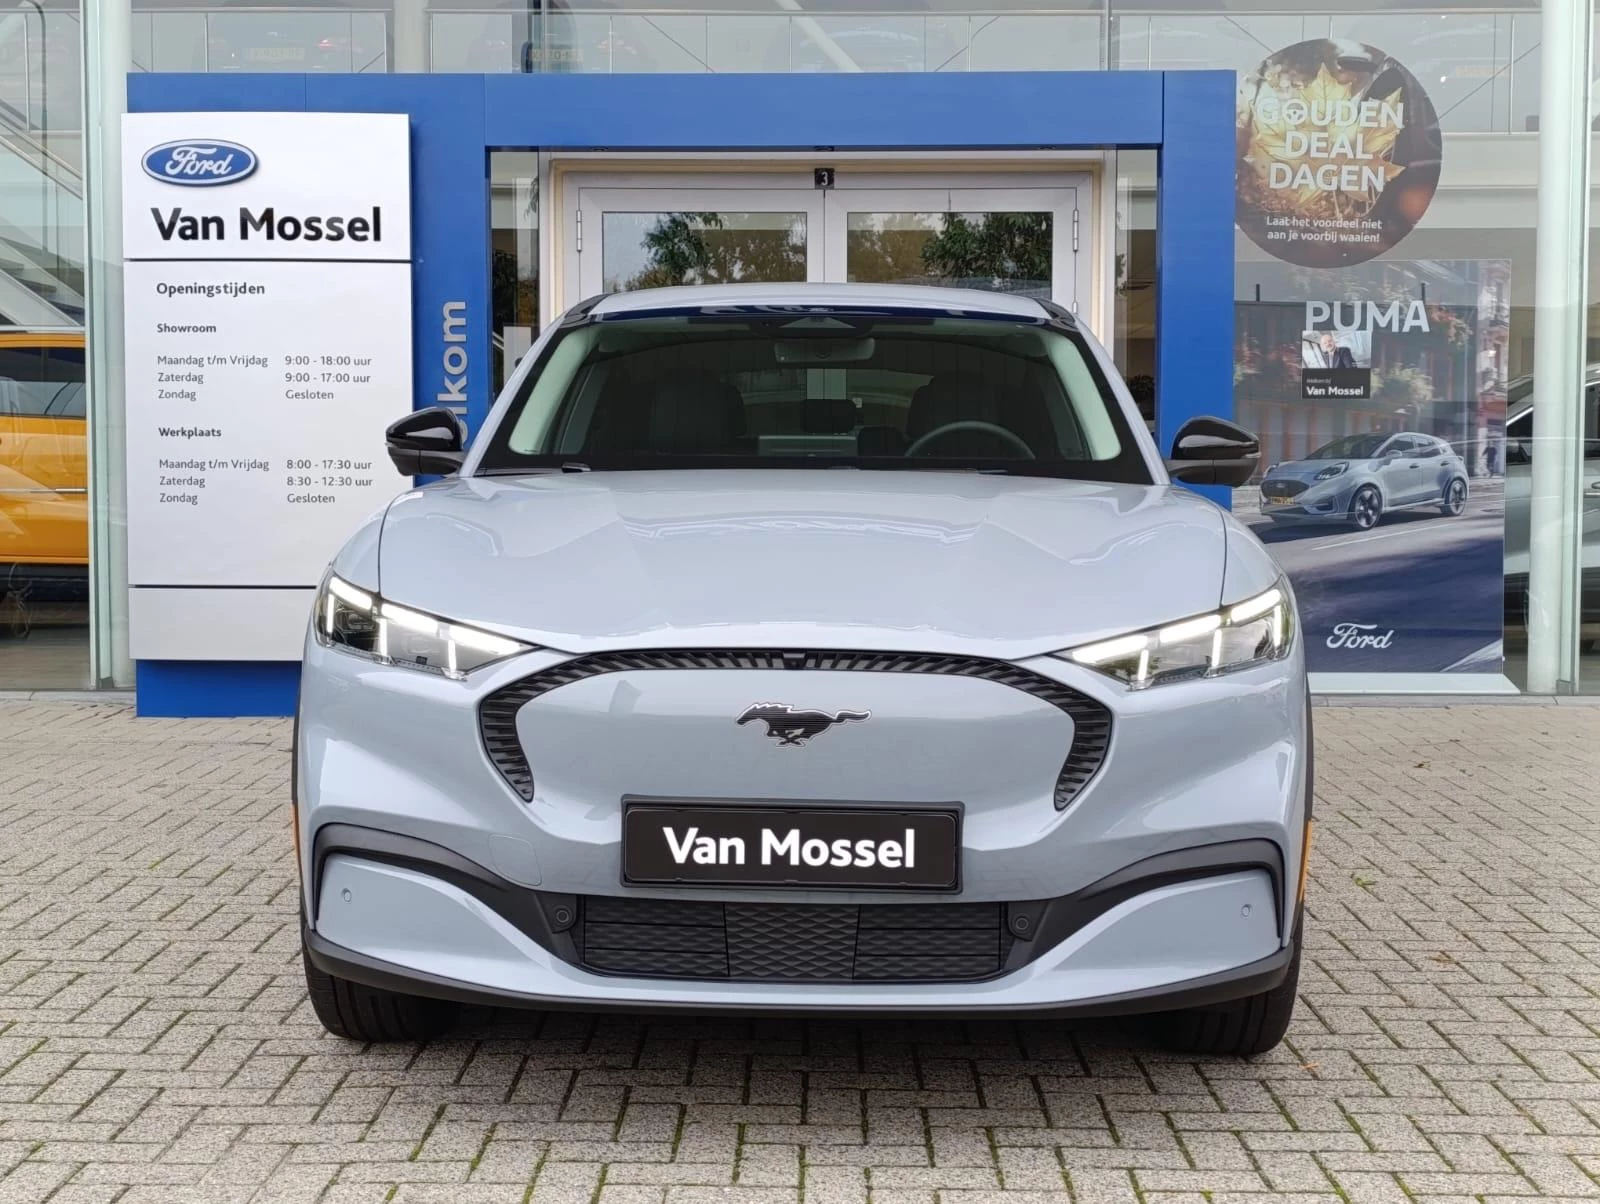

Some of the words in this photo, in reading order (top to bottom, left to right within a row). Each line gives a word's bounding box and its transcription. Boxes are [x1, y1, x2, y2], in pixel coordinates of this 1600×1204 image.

[1256, 97, 1404, 128] GOUDEN
[1285, 131, 1373, 159] DEAL
[165, 146, 233, 176] Ford
[821, 171, 828, 186] 3
[1269, 163, 1385, 192] DAGEN
[150, 207, 224, 241] Van
[240, 206, 381, 241] Mossel
[1267, 216, 1289, 226] Laat
[1292, 217, 1310, 227] het
[1313, 218, 1358, 228] voordeel
[1362, 219, 1382, 229] niet
[1267, 231, 1285, 239] aan
[1288, 230, 1298, 241] je
[1301, 230, 1337, 243] voorbij
[1340, 231, 1380, 242] waaien!
[156, 283, 265, 297] Openingstijden
[1306, 300, 1430, 332] PUMA
[157, 323, 216, 333] Showroom
[157, 356, 204, 367] Maandag
[207, 356, 226, 365] t/m
[230, 356, 268, 368] Vrijdag
[285, 356, 310, 365] 9:00
[320, 356, 351, 365] 18:00
[354, 357, 371, 365] uur
[158, 372, 204, 384] Zaterdag
[285, 373, 310, 382] 9:00
[321, 373, 350, 382] 17:00
[353, 374, 371, 383] uur
[158, 389, 196, 401] Zondag
[286, 390, 334, 399] Gesloten
[1307, 386, 1325, 395] Van
[1328, 386, 1363, 395] Mossel
[158, 428, 221, 440] Werkplaats
[159, 459, 205, 471] Maandag
[209, 459, 228, 469] t/m
[231, 459, 269, 472] Vrijdag
[287, 460, 311, 469] 8:00
[322, 460, 351, 469] 17:30
[354, 461, 372, 469] uur
[160, 476, 205, 488] Zaterdag
[287, 477, 311, 486] 8:30
[322, 477, 352, 486] 12:30
[355, 478, 372, 486] uur
[160, 493, 198, 505] Zondag
[287, 494, 335, 503] Gesloten
[1327, 623, 1394, 648] Ford
[663, 827, 745, 865] Van
[762, 829, 915, 868] Mossel
